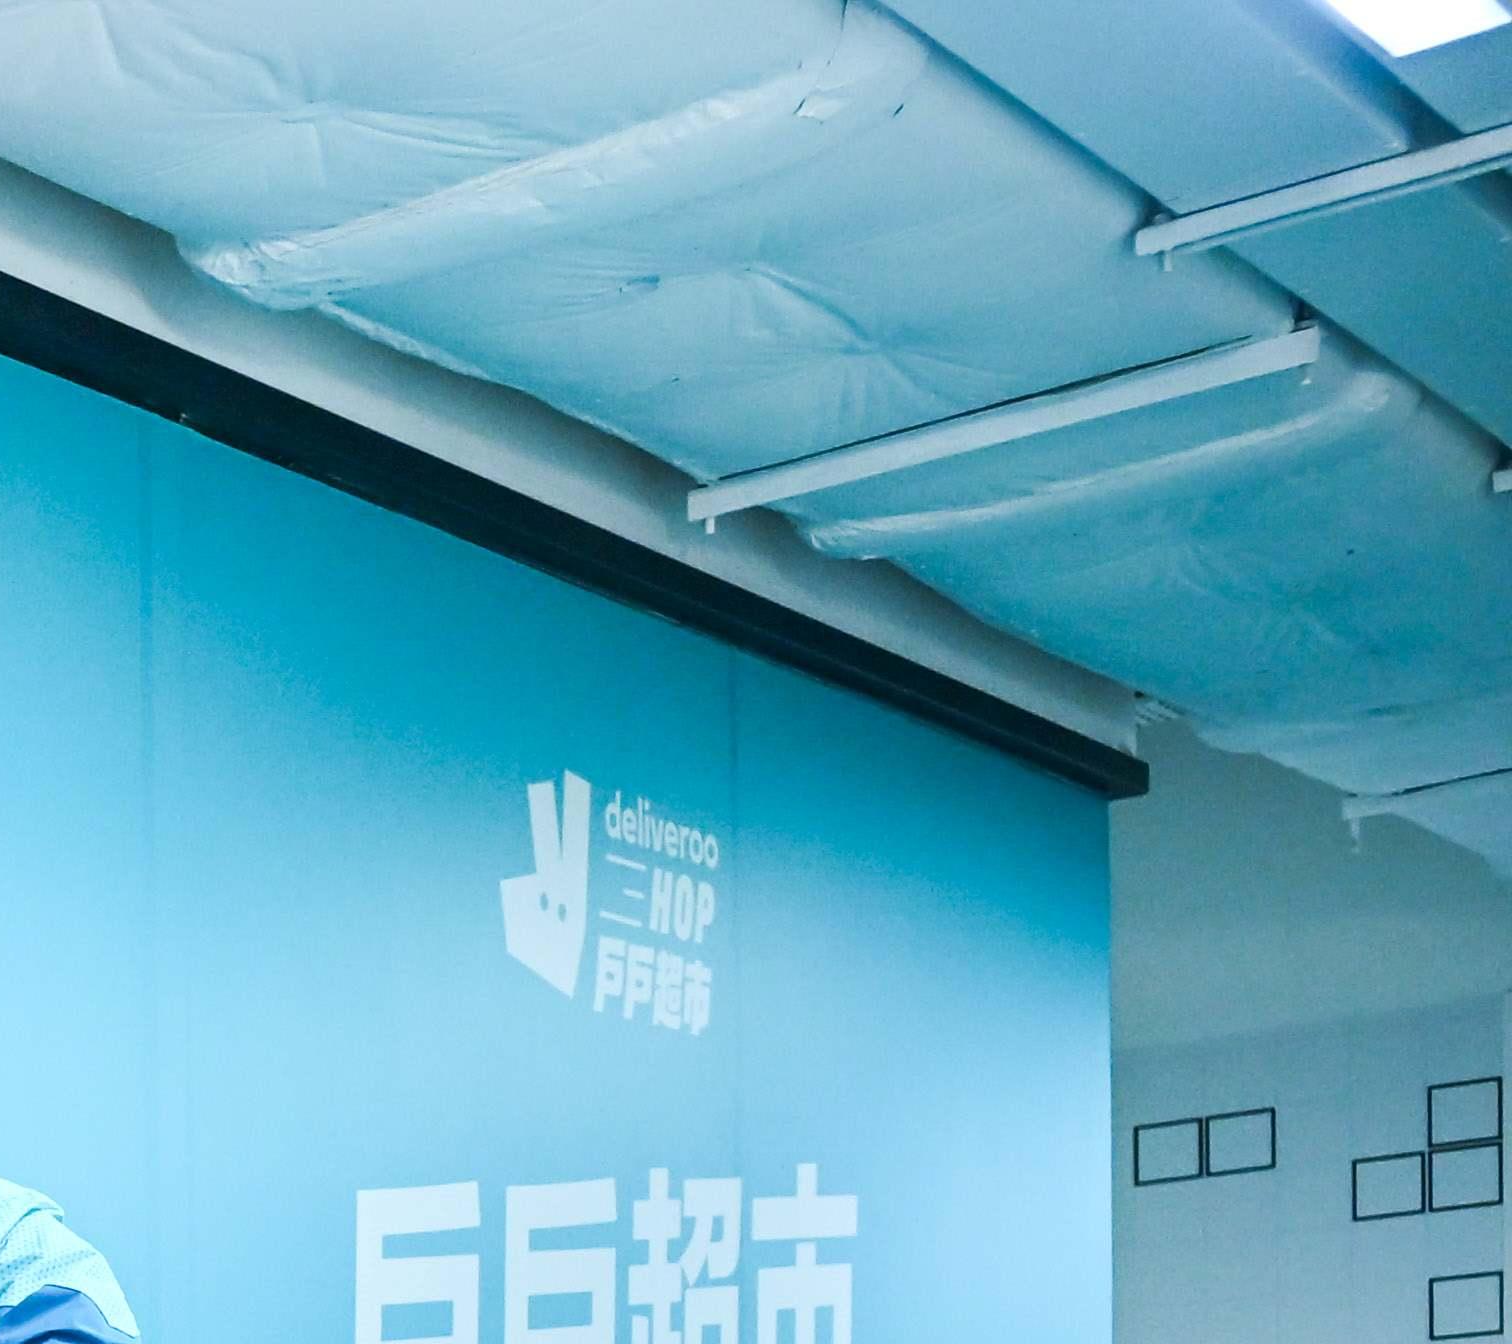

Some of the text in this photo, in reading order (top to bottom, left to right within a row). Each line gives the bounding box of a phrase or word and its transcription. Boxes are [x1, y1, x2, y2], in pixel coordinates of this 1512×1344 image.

[604, 790, 719, 869] deliveroo
[649, 867, 715, 943] HOP
[593, 935, 712, 1036] 戶戶超市
